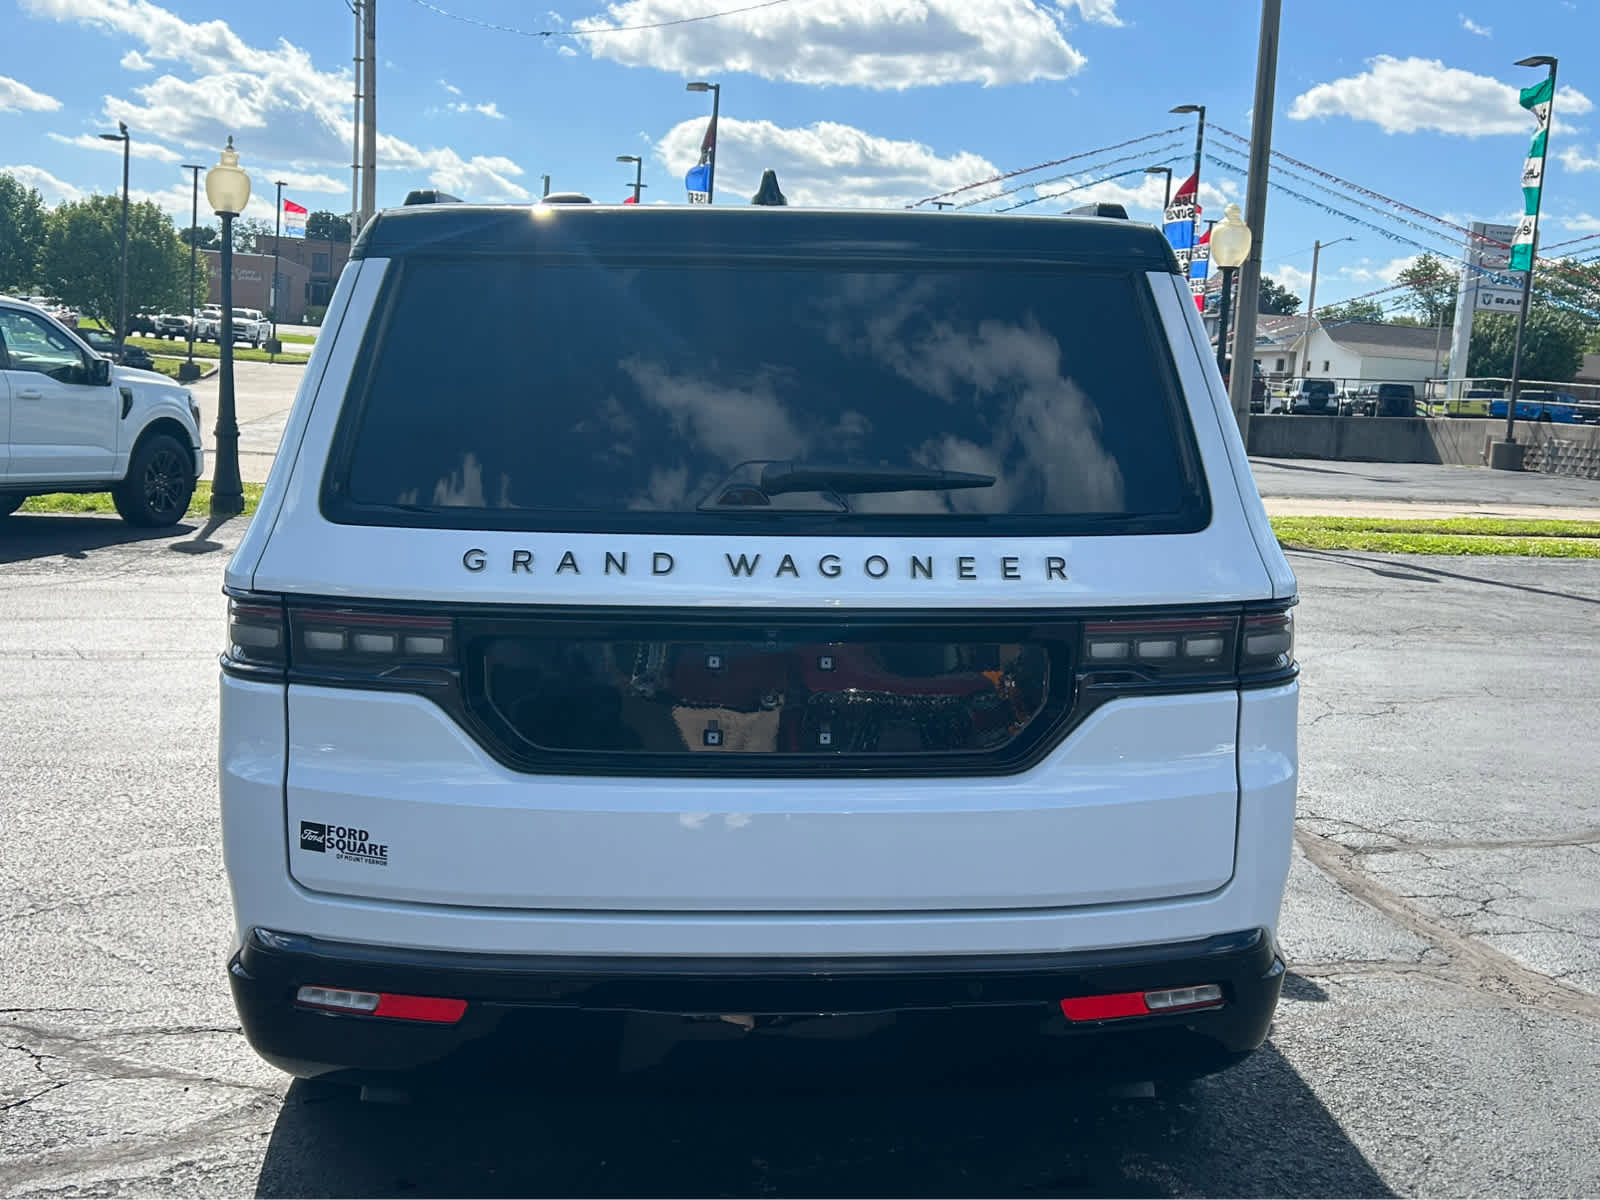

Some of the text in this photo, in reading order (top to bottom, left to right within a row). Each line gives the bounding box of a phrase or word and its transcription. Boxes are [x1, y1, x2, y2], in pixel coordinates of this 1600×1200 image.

[462, 548, 1070, 582] GRAND WAGONEER
[301, 829, 325, 844] Ford
[326, 825, 368, 842] FORD
[326, 837, 388, 857] SQUARE
[344, 855, 363, 863] MOUNT
